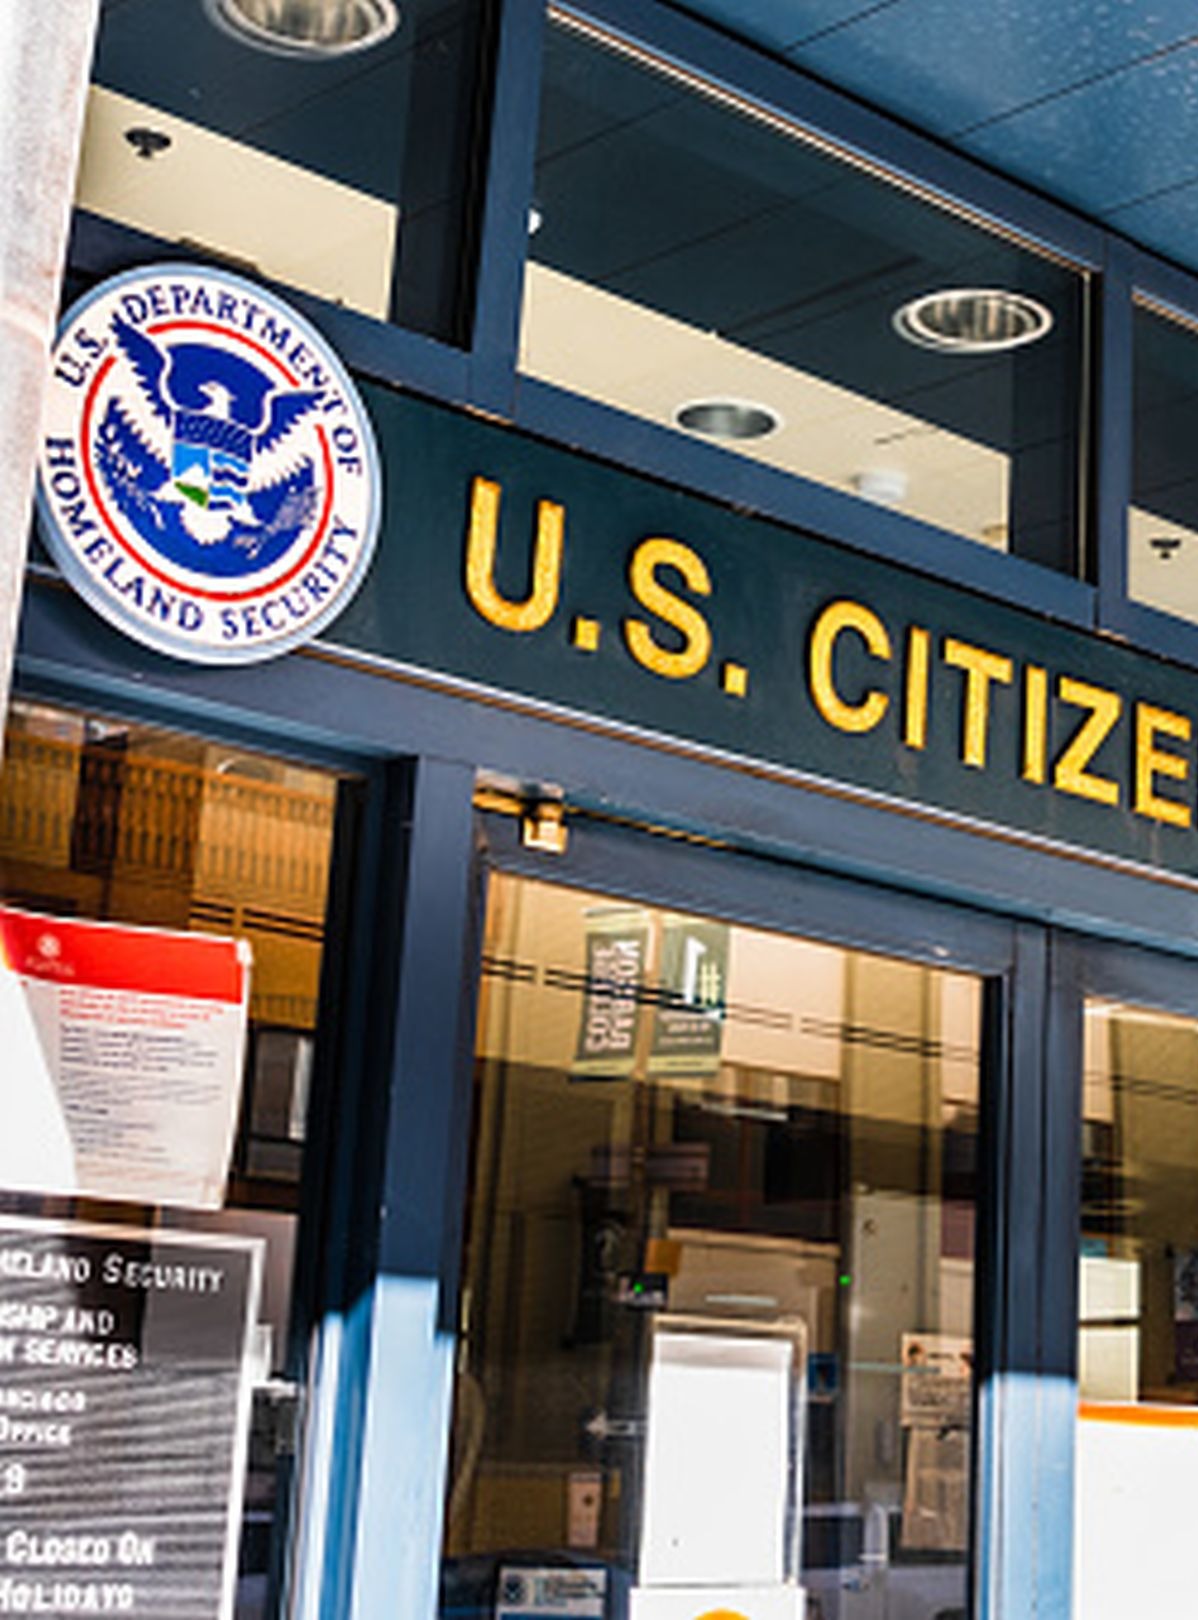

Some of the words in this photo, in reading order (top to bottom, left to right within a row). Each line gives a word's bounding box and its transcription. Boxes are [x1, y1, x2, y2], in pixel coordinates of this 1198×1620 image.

[53, 327, 109, 389] U.S.
[120, 284, 348, 416] DEPARTMENT
[331, 422, 363, 478] OF
[45, 436, 205, 633] HOMELAND
[221, 513, 359, 640] SECURITY
[465, 475, 749, 698] U.S.
[60, 1306, 115, 1335] AND
[102, 1253, 223, 1293] SECURITY
[24, 1338, 138, 1369] SERVICES
